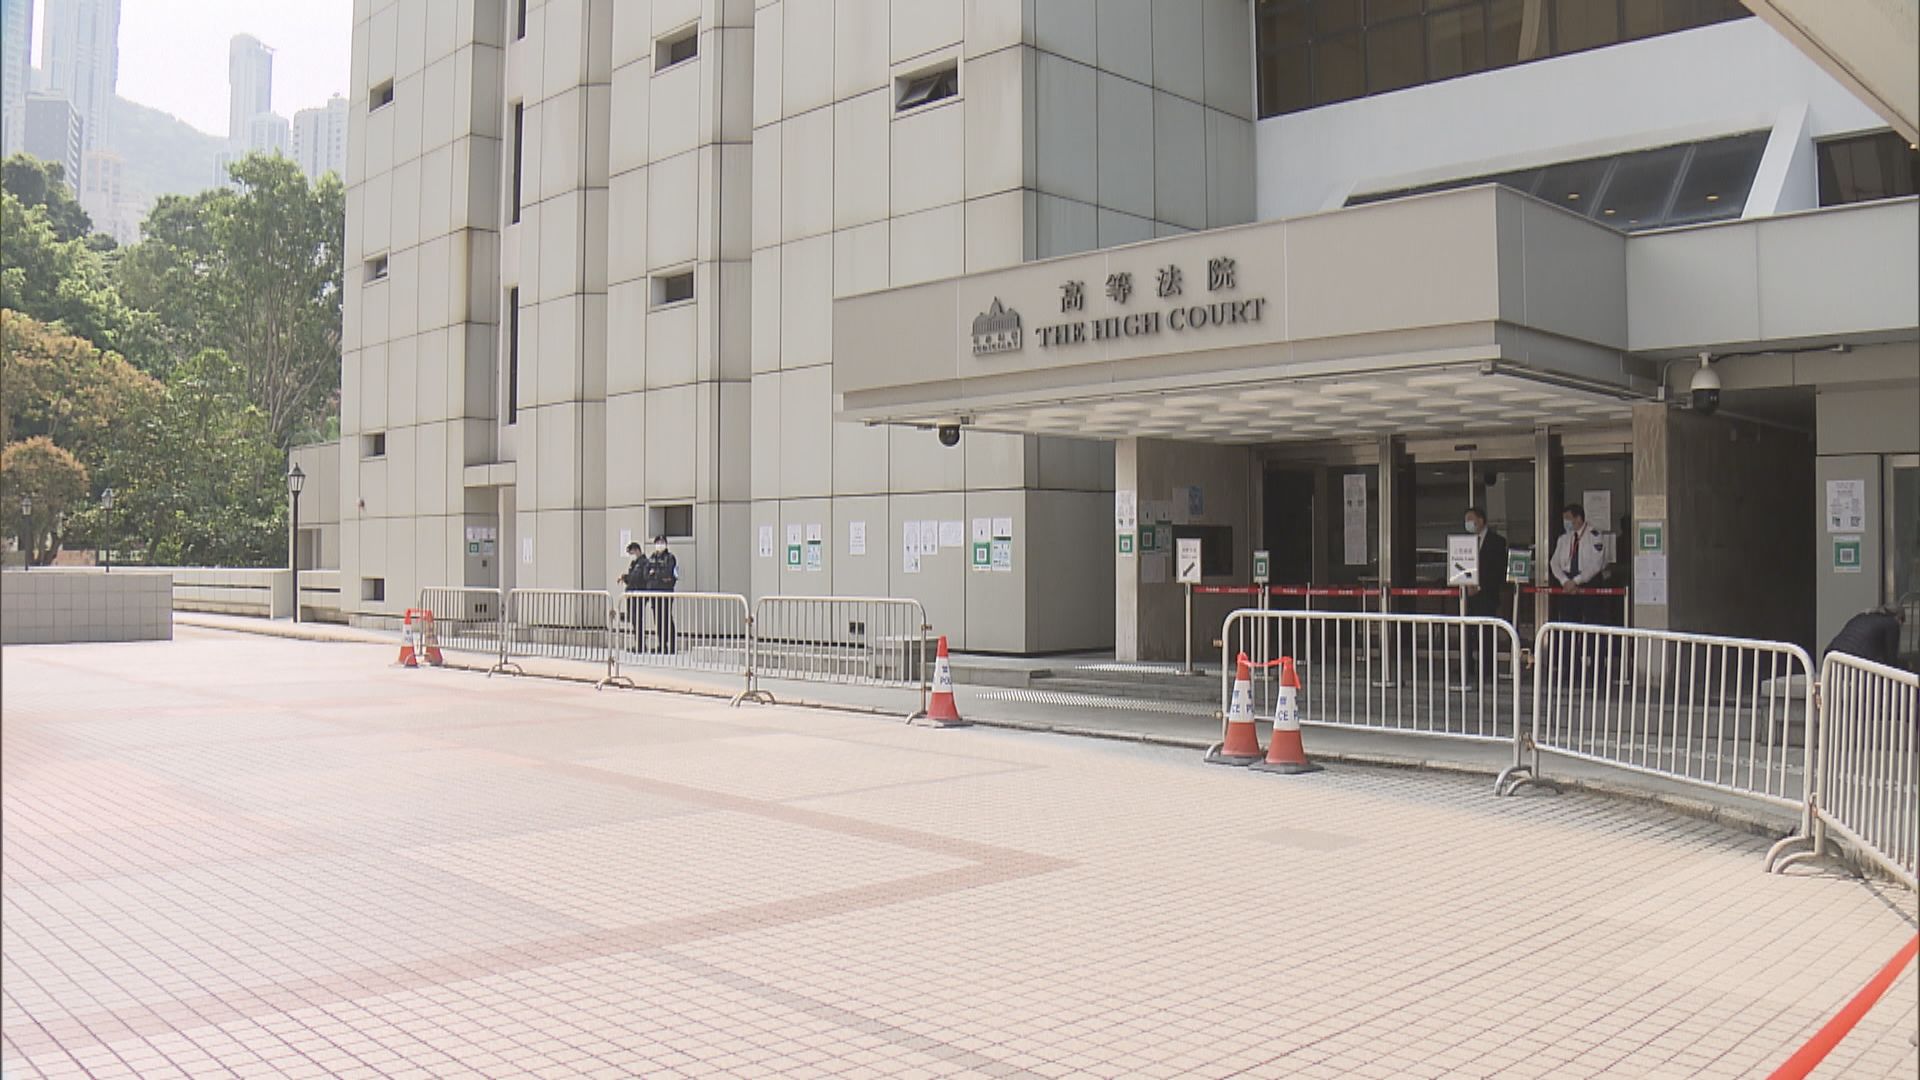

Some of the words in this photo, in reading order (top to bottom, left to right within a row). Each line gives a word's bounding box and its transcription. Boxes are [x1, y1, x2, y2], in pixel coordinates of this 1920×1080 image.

[1059, 256, 1236, 313] 高等法院
[1035, 321, 1086, 347] THE
[1091, 311, 1161, 341] HIGH
[1167, 297, 1266, 332] COURT
